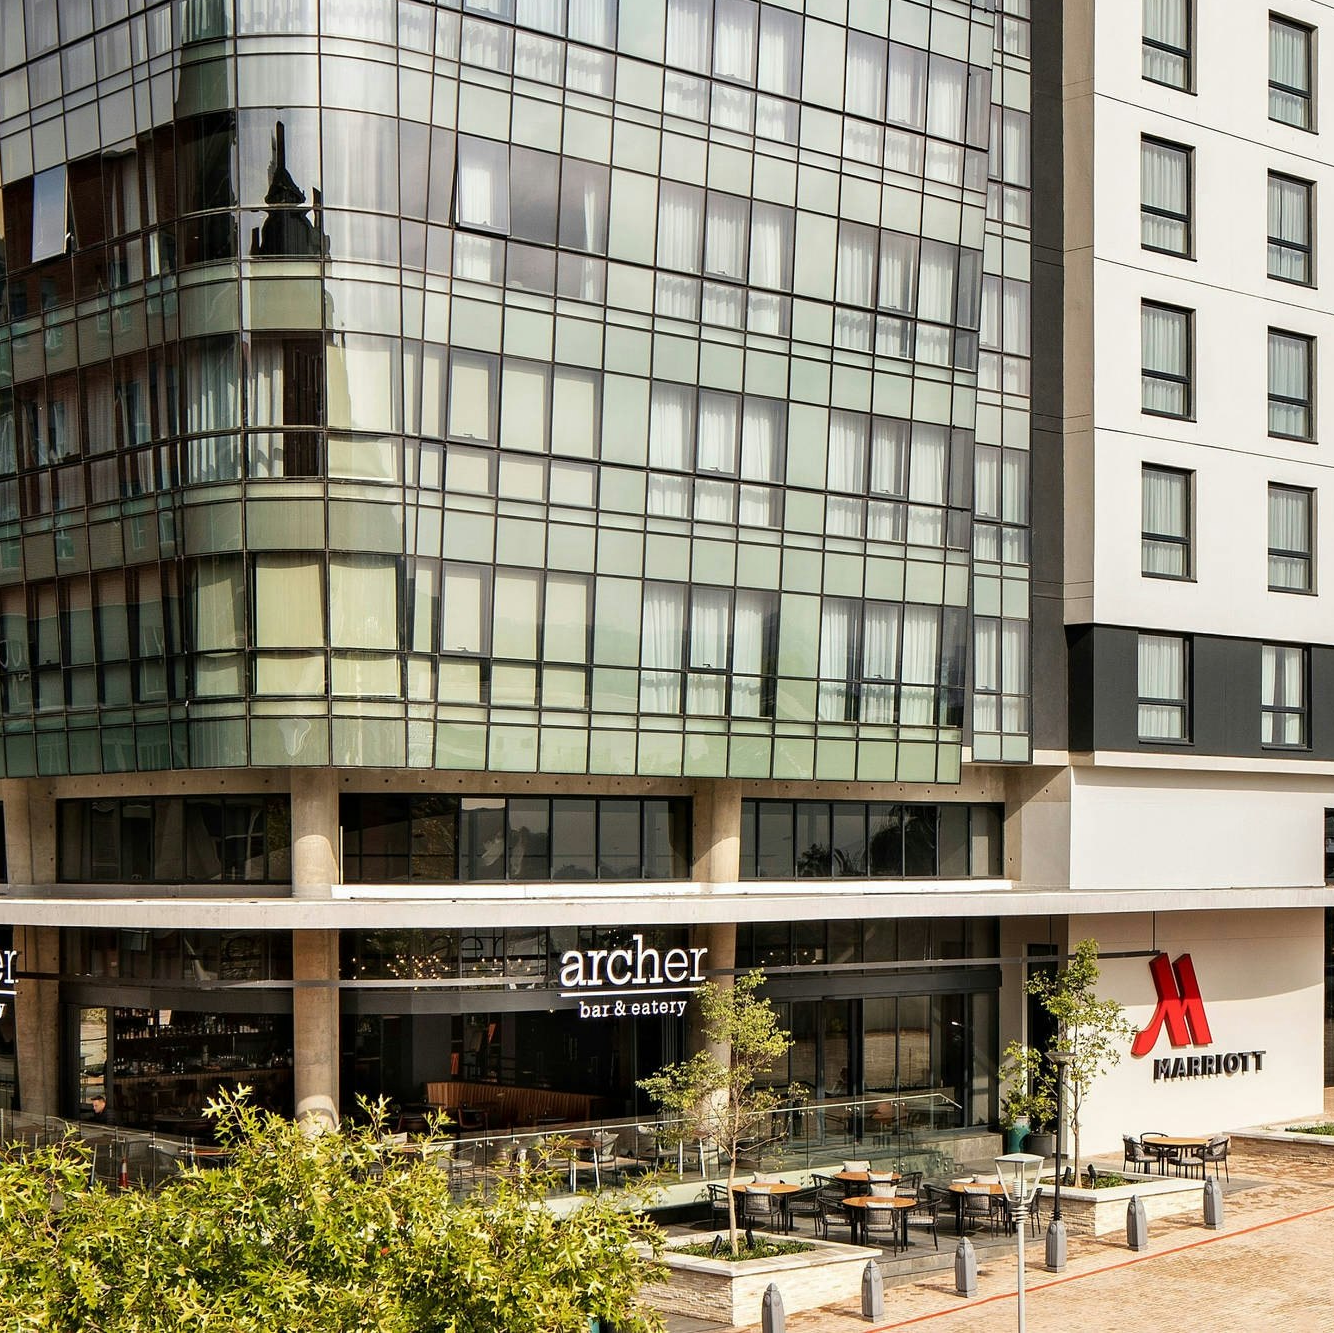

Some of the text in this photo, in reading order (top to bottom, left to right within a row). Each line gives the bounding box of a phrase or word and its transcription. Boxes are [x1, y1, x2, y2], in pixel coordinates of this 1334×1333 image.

[560, 934, 708, 987] archer
[579, 999, 687, 1018] bar & eatery
[1153, 1050, 1267, 1081] MARRIOTT
